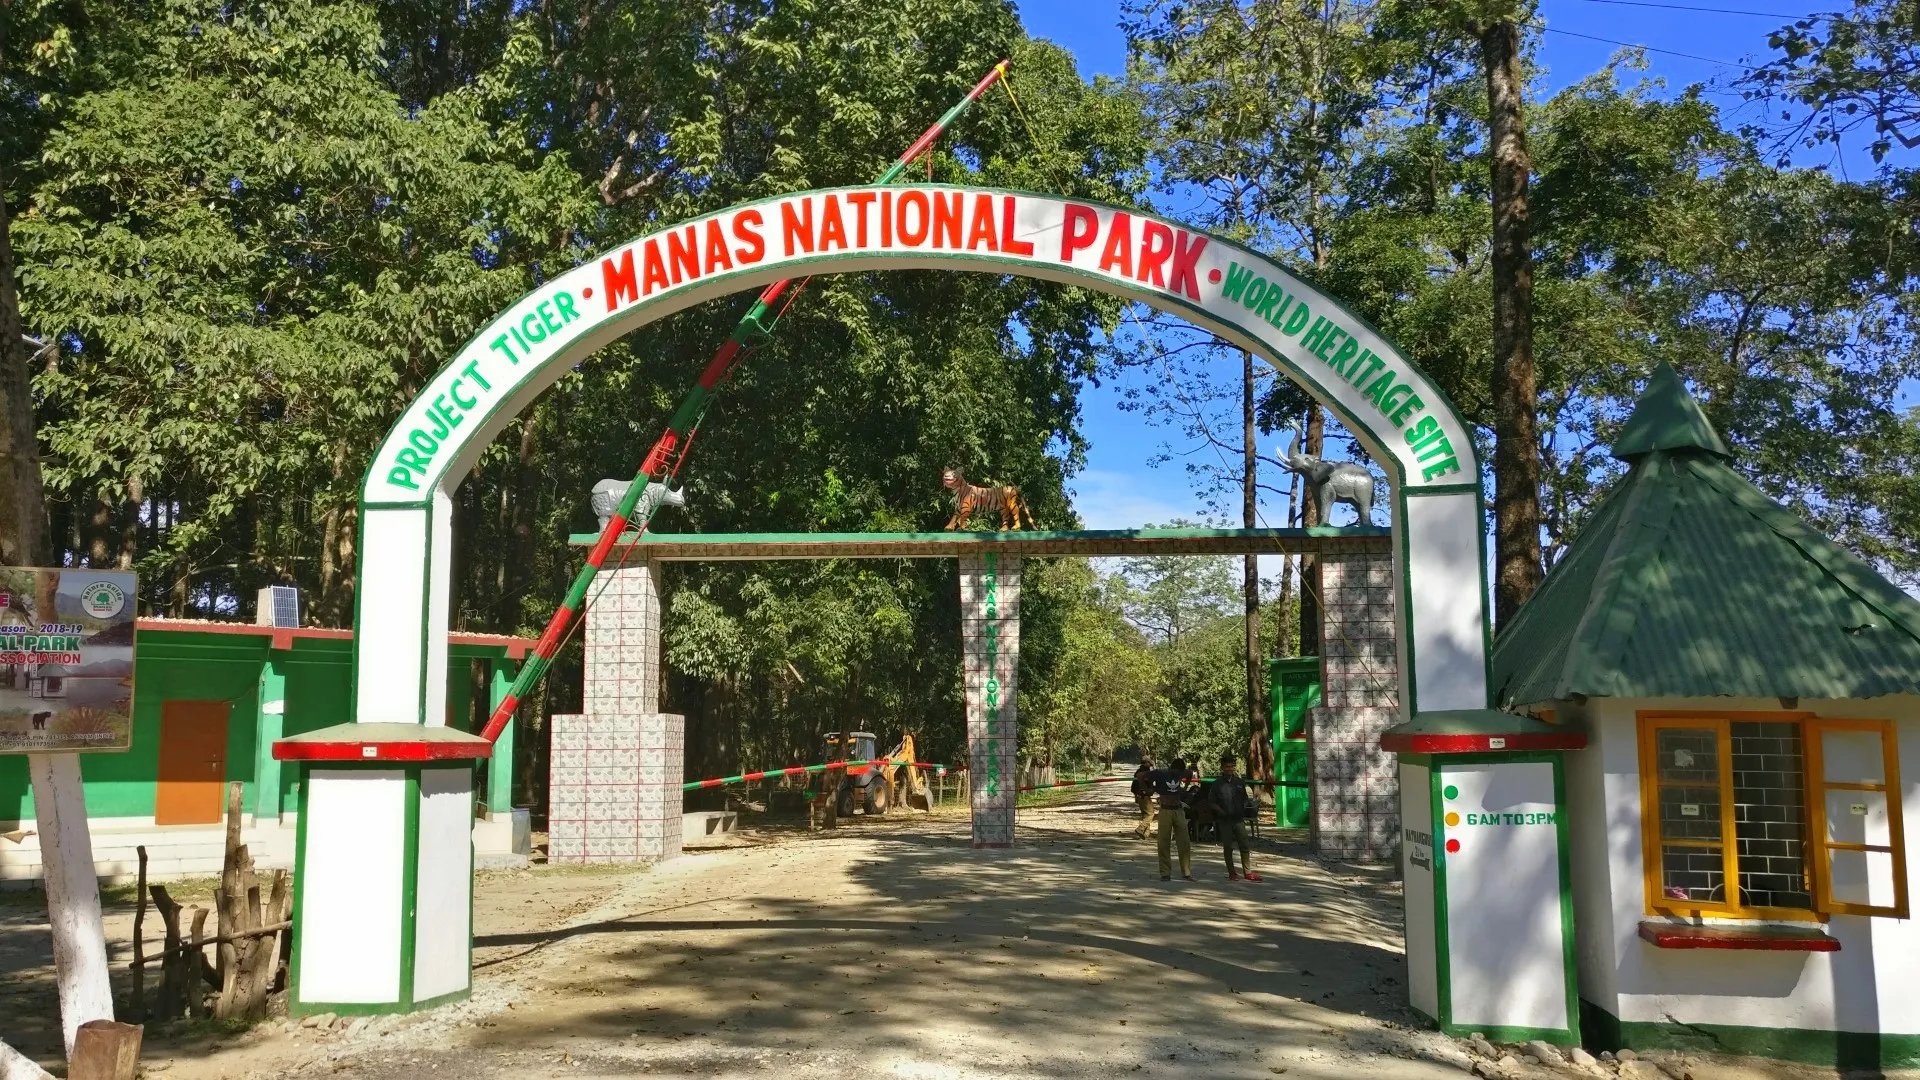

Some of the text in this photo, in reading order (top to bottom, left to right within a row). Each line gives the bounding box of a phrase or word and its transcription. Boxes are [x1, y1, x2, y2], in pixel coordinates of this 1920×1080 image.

[387, 191, 1461, 490] PROJECT TIGER MANAS NATIONAL PARK WORLD HERITAGE SITE
[0, 626, 26, 634] ason
[40, 624, 83, 634] 2018-19
[24, 636, 80, 651] PARK
